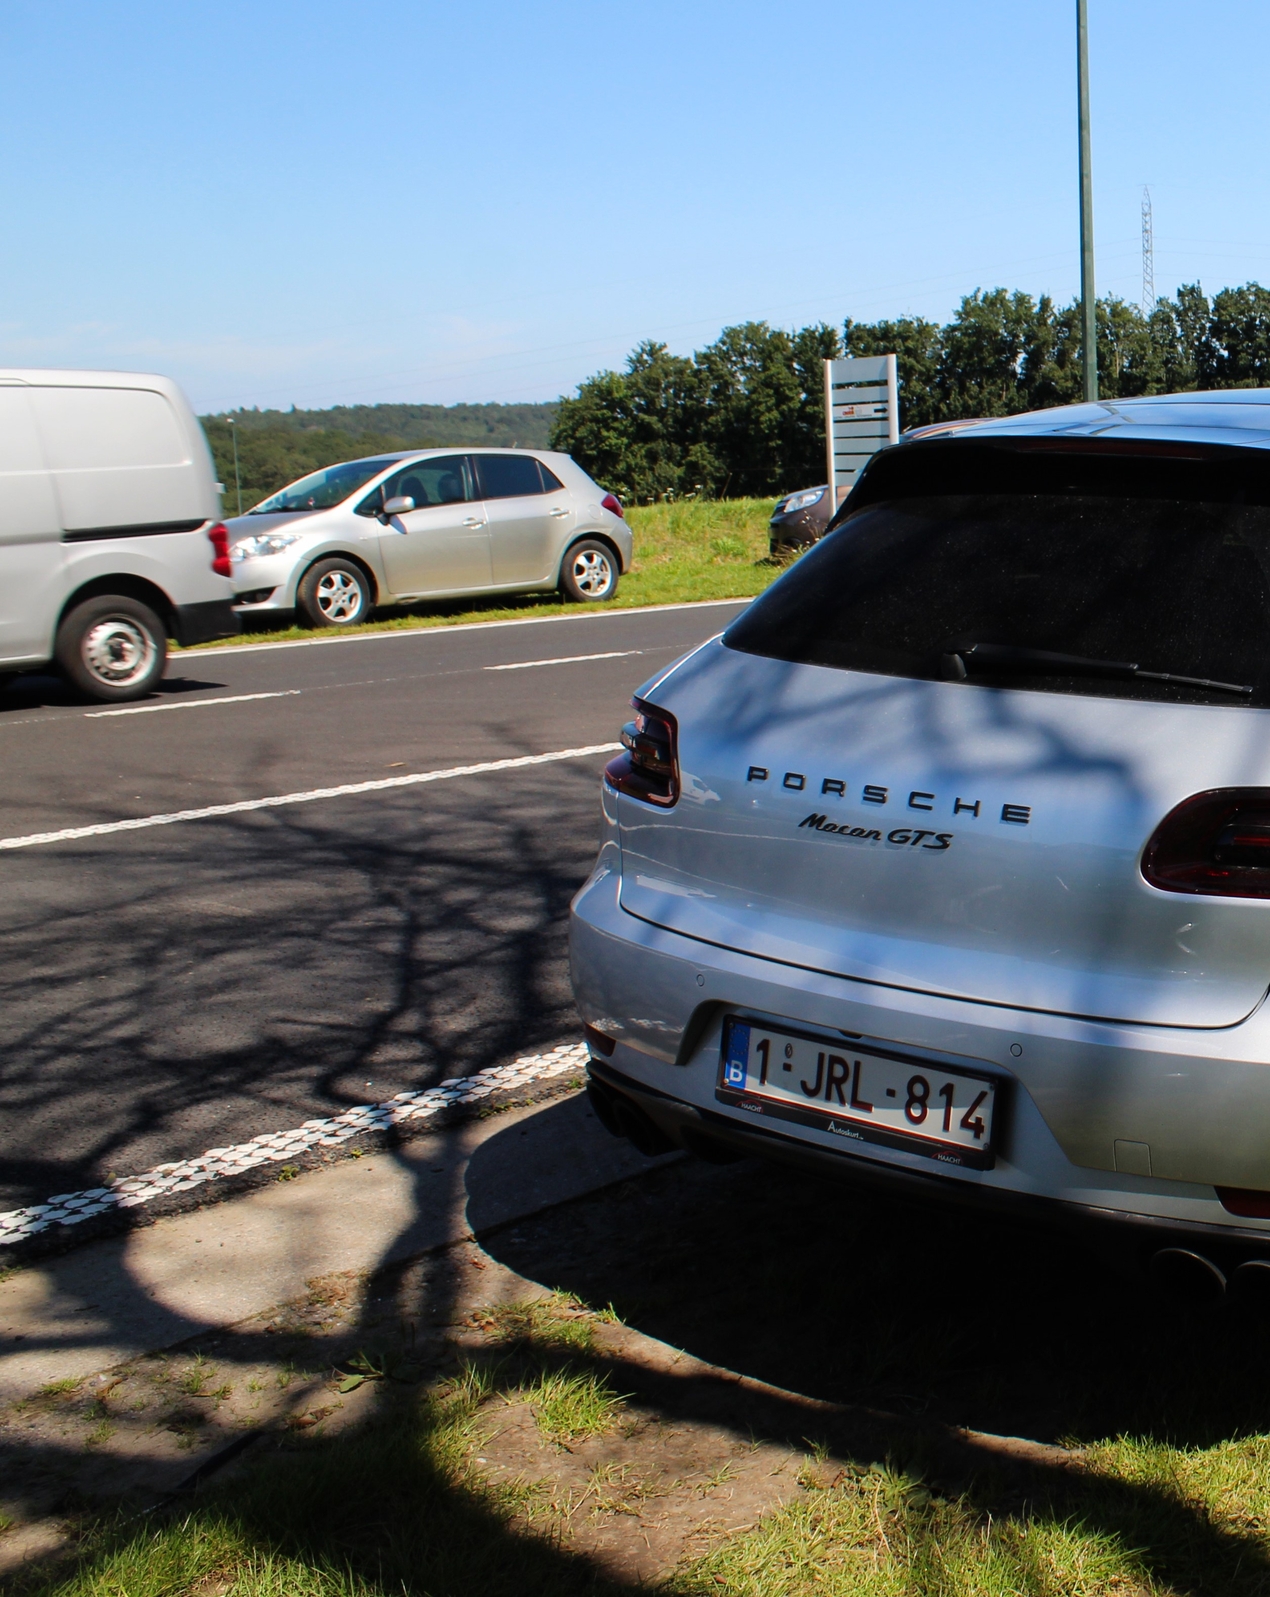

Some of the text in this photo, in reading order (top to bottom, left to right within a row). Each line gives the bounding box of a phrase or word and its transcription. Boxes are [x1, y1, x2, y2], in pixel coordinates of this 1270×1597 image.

[747, 765, 1032, 825] PORSCHE
[799, 812, 953, 850] Macan GTS
[729, 1060, 743, 1083] B
[756, 1038, 989, 1140] 1-JRL-814
[937, 1153, 961, 1165] HAACHT
